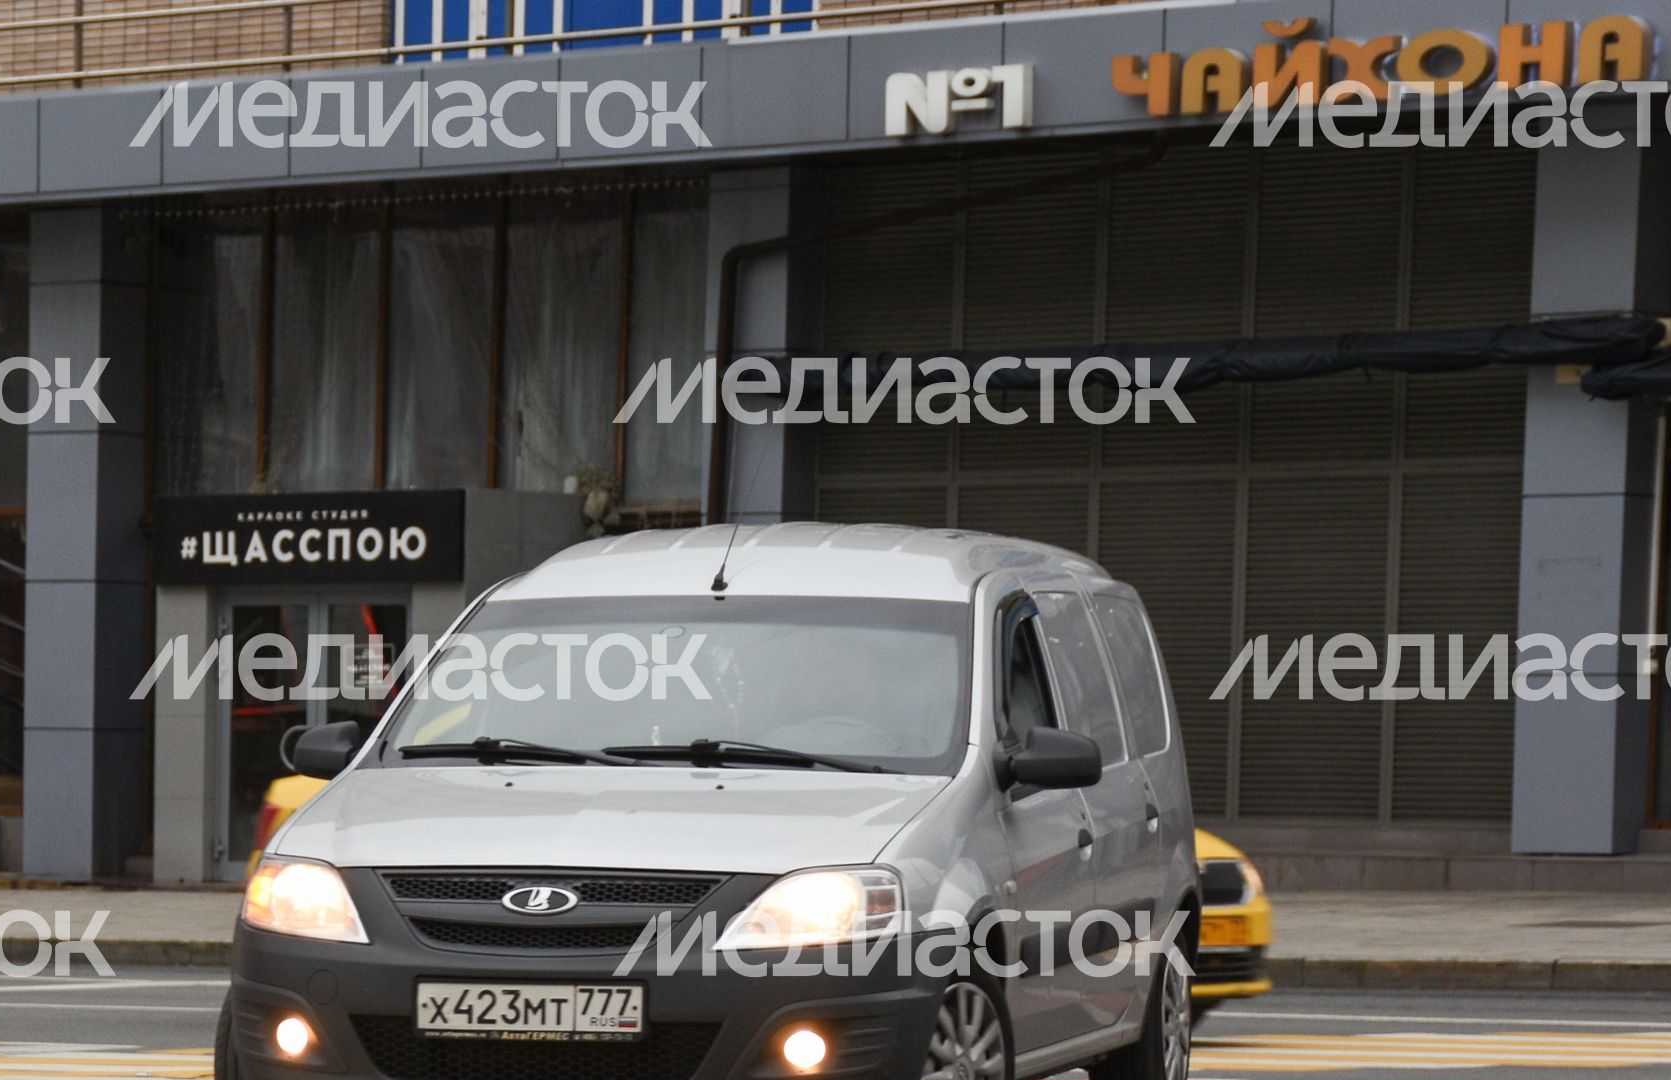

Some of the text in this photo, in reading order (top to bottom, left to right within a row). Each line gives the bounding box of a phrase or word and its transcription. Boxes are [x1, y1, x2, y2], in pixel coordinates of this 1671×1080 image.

[1111, 15, 1653, 117] ЧАЙХОНА
[237, 509, 369, 522] КАРАОКЕ СТУДИЯ
[181, 526, 427, 566] #ЩАССПОЮ
[578, 988, 633, 1017] 777
[590, 1016, 617, 1027] RUS
